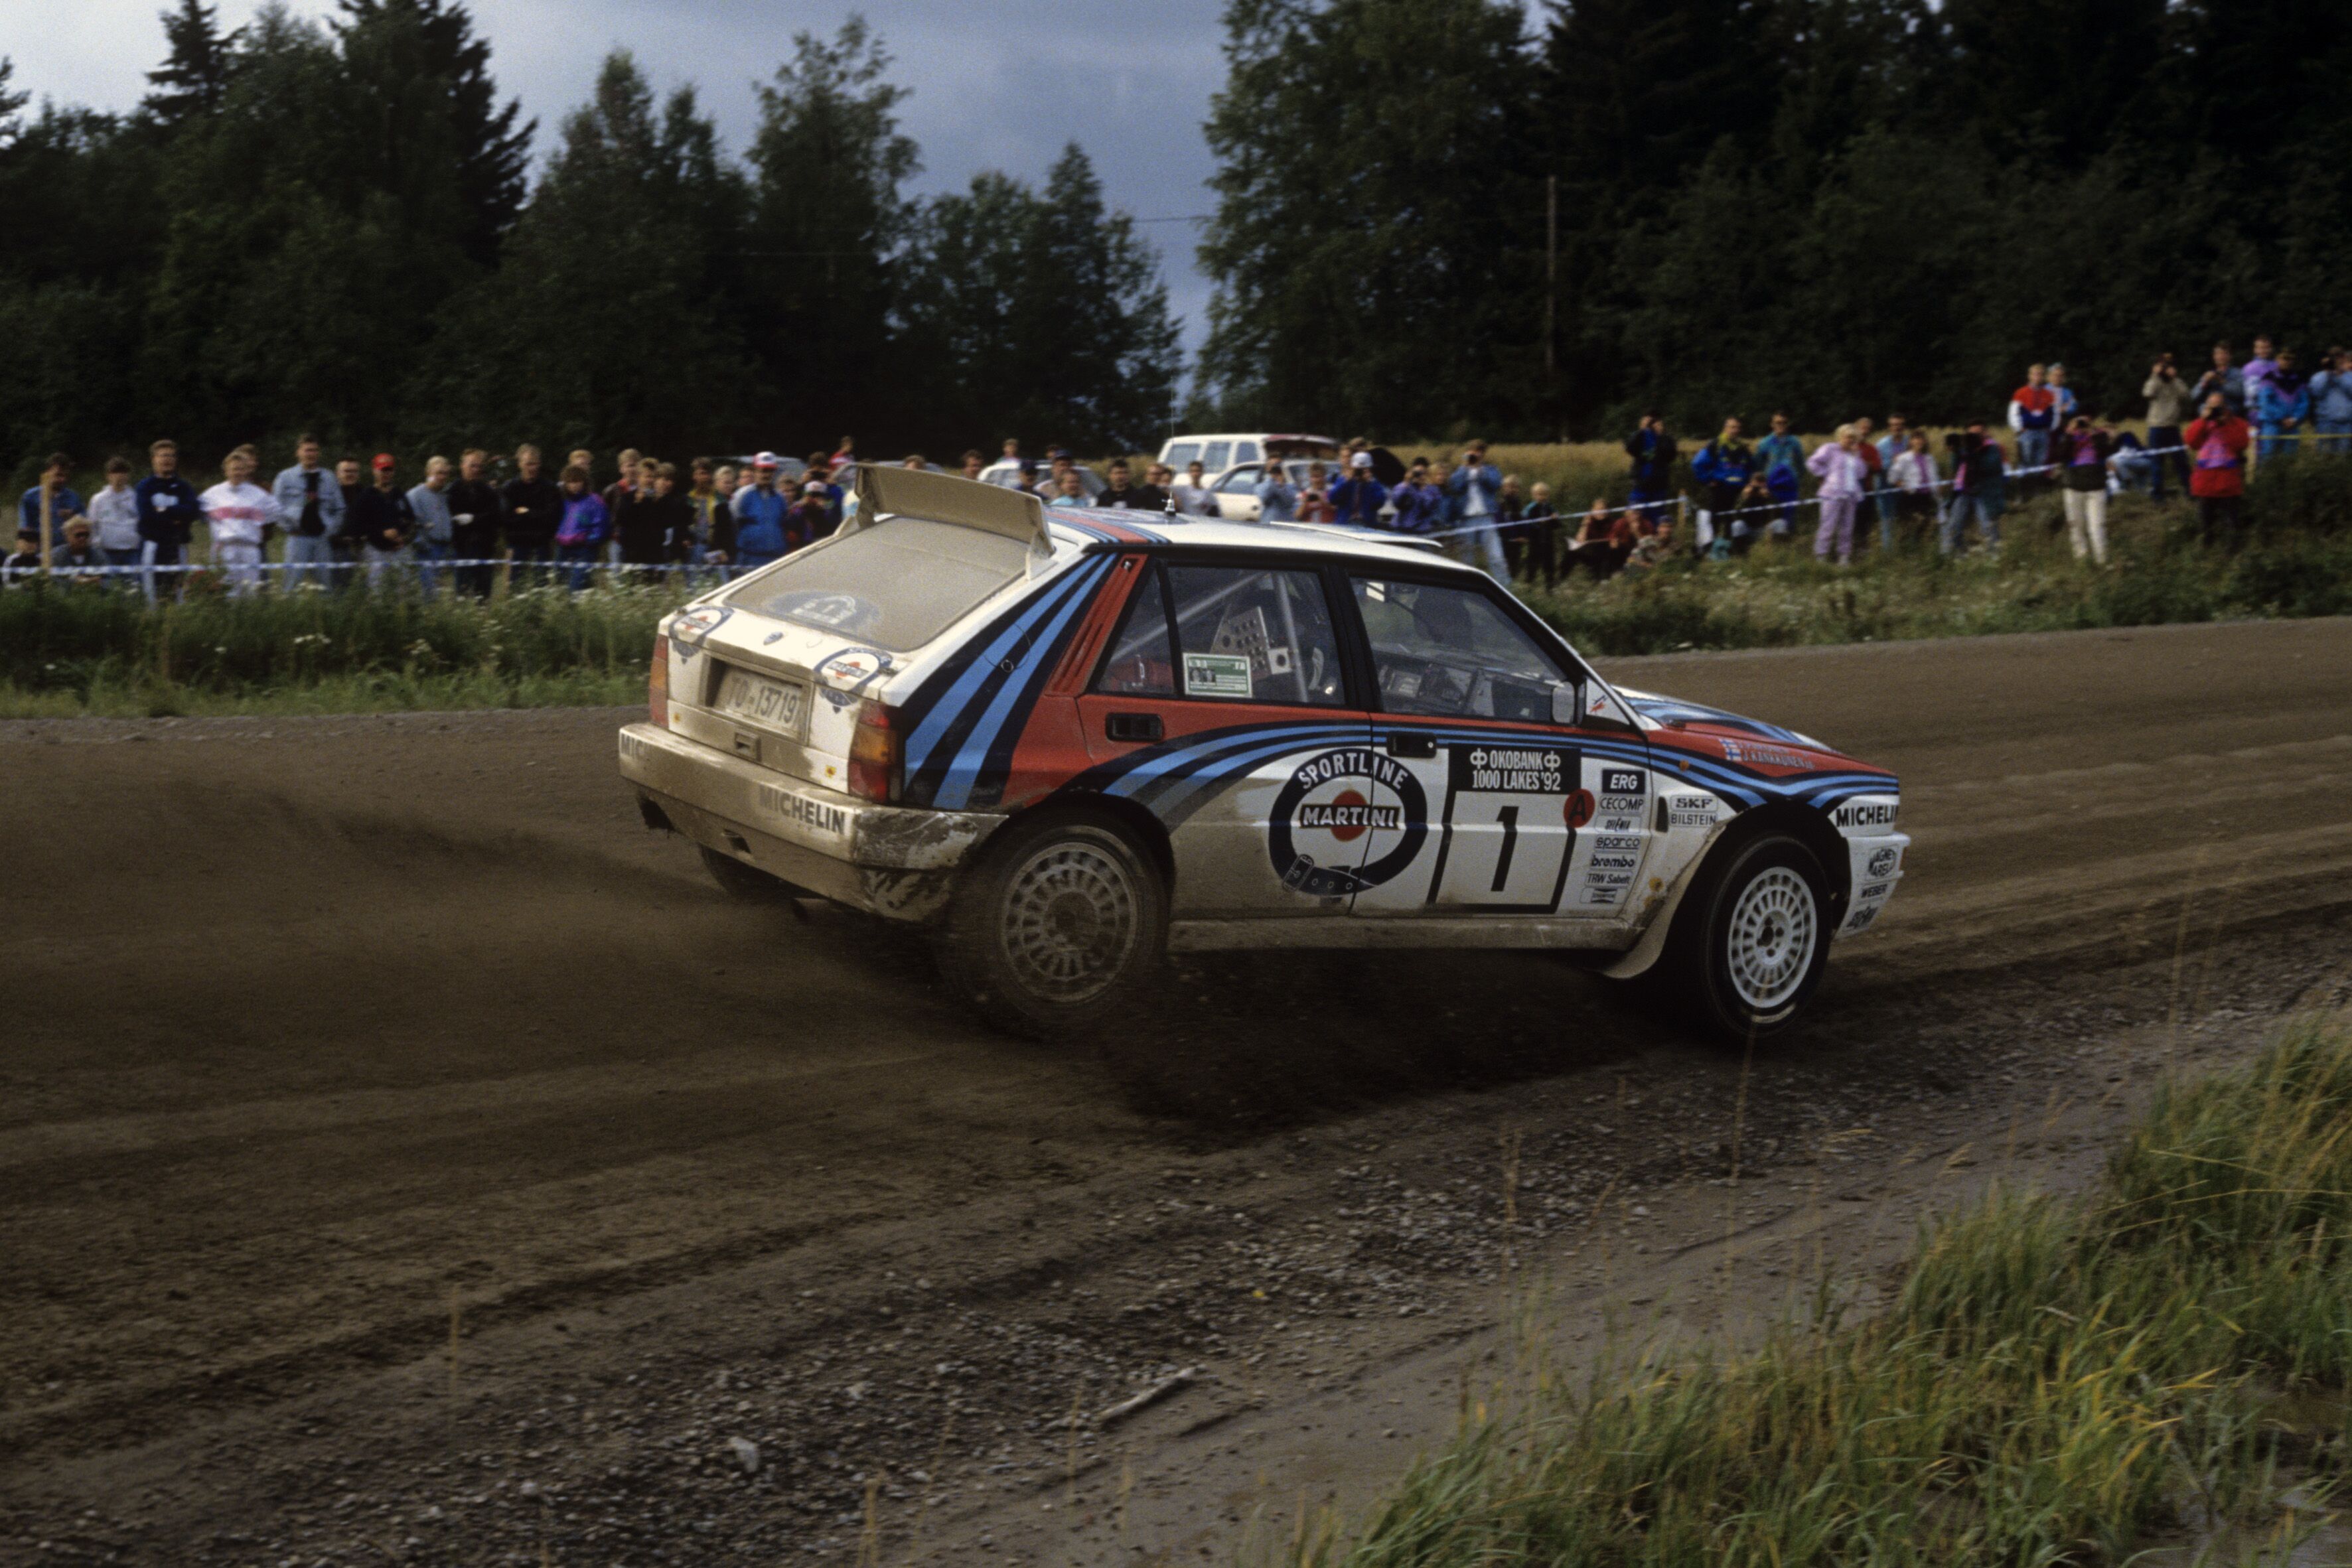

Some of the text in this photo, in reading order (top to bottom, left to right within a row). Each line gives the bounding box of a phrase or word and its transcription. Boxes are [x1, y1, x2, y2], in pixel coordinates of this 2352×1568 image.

[1489, 750, 1543, 770] OKOBANK
[1298, 752, 1408, 790] SPORTLINE
[1472, 770, 1501, 789] 1000
[1610, 774, 1638, 790] ERG
[759, 784, 845, 836] MICHELIN
[1568, 794, 1586, 821] A
[1599, 798, 1644, 811] CECOMP
[1676, 798, 1713, 809] SKF
[1302, 806, 1396, 827] MARTINI
[1670, 814, 1717, 825] BILSTEIN
[1490, 806, 1519, 892] 1
[1595, 837, 1640, 850] sparco
[1591, 854, 1635, 868] brembo
[1587, 873, 1606, 884] TRW
